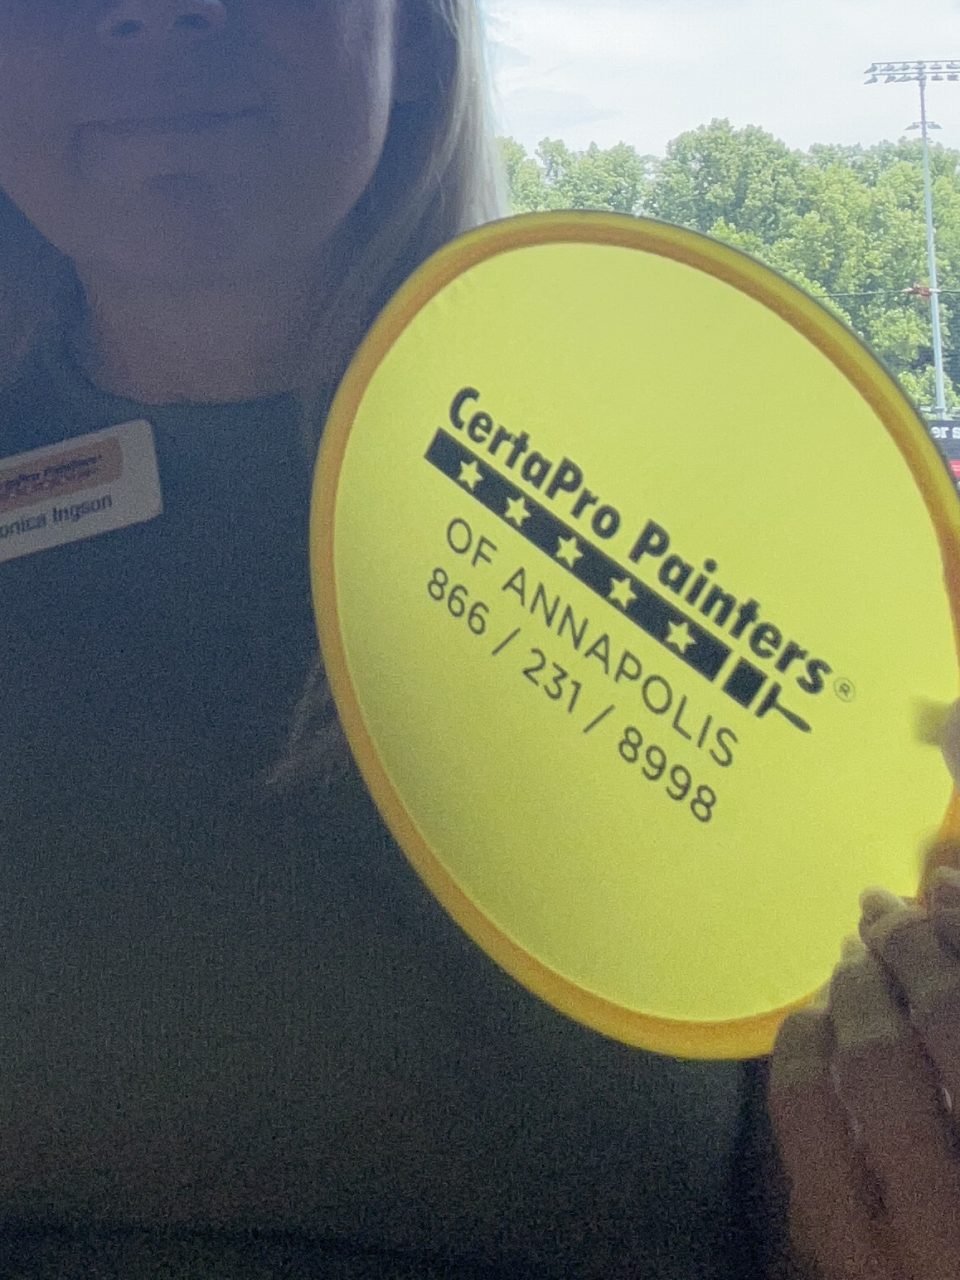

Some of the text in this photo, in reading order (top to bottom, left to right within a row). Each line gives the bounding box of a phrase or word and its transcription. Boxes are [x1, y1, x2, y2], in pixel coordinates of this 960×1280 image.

[446, 517, 739, 768] OF ANNAPOLIS
[448, 386, 833, 695] CertaPro Painters
[427, 567, 718, 823] 866 / 231 / 8998
